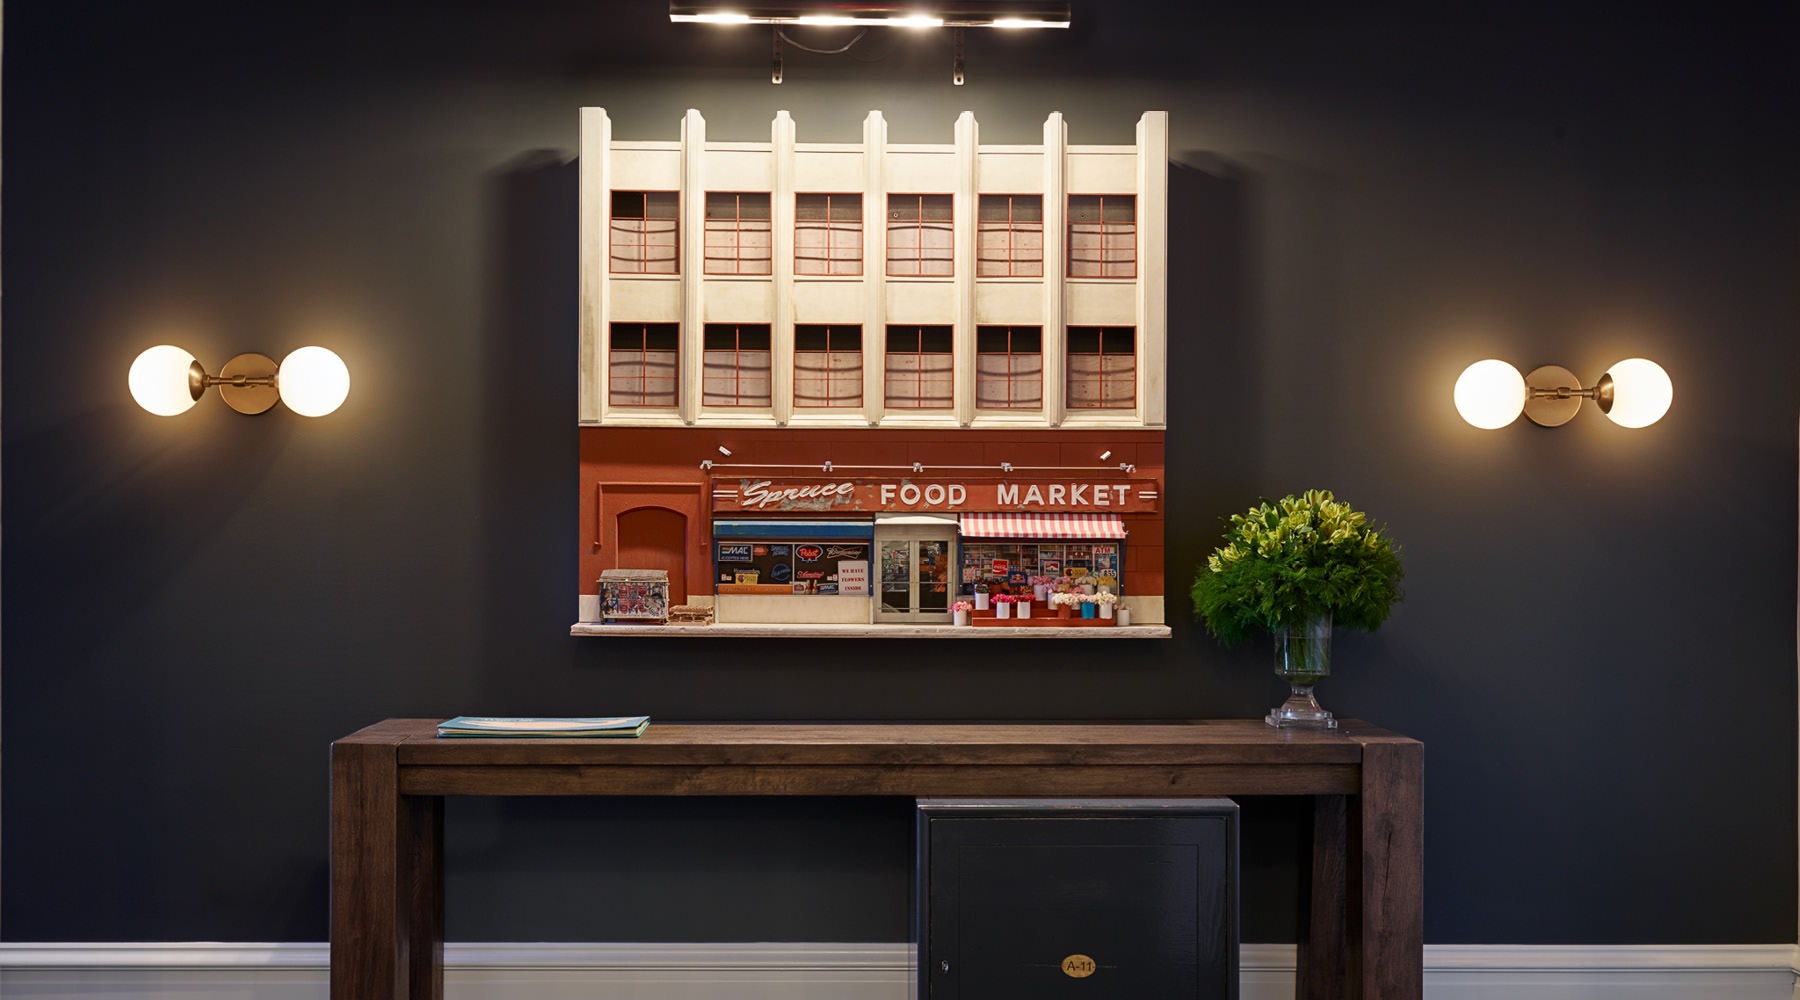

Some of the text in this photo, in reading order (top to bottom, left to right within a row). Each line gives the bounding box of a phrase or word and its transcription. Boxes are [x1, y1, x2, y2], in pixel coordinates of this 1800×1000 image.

[741, 480, 1131, 508] Spruce FOOD MARKET
[729, 546, 749, 554] MAC
[1095, 546, 1111, 554] ATM
[1066, 960, 1092, 972] A-11
